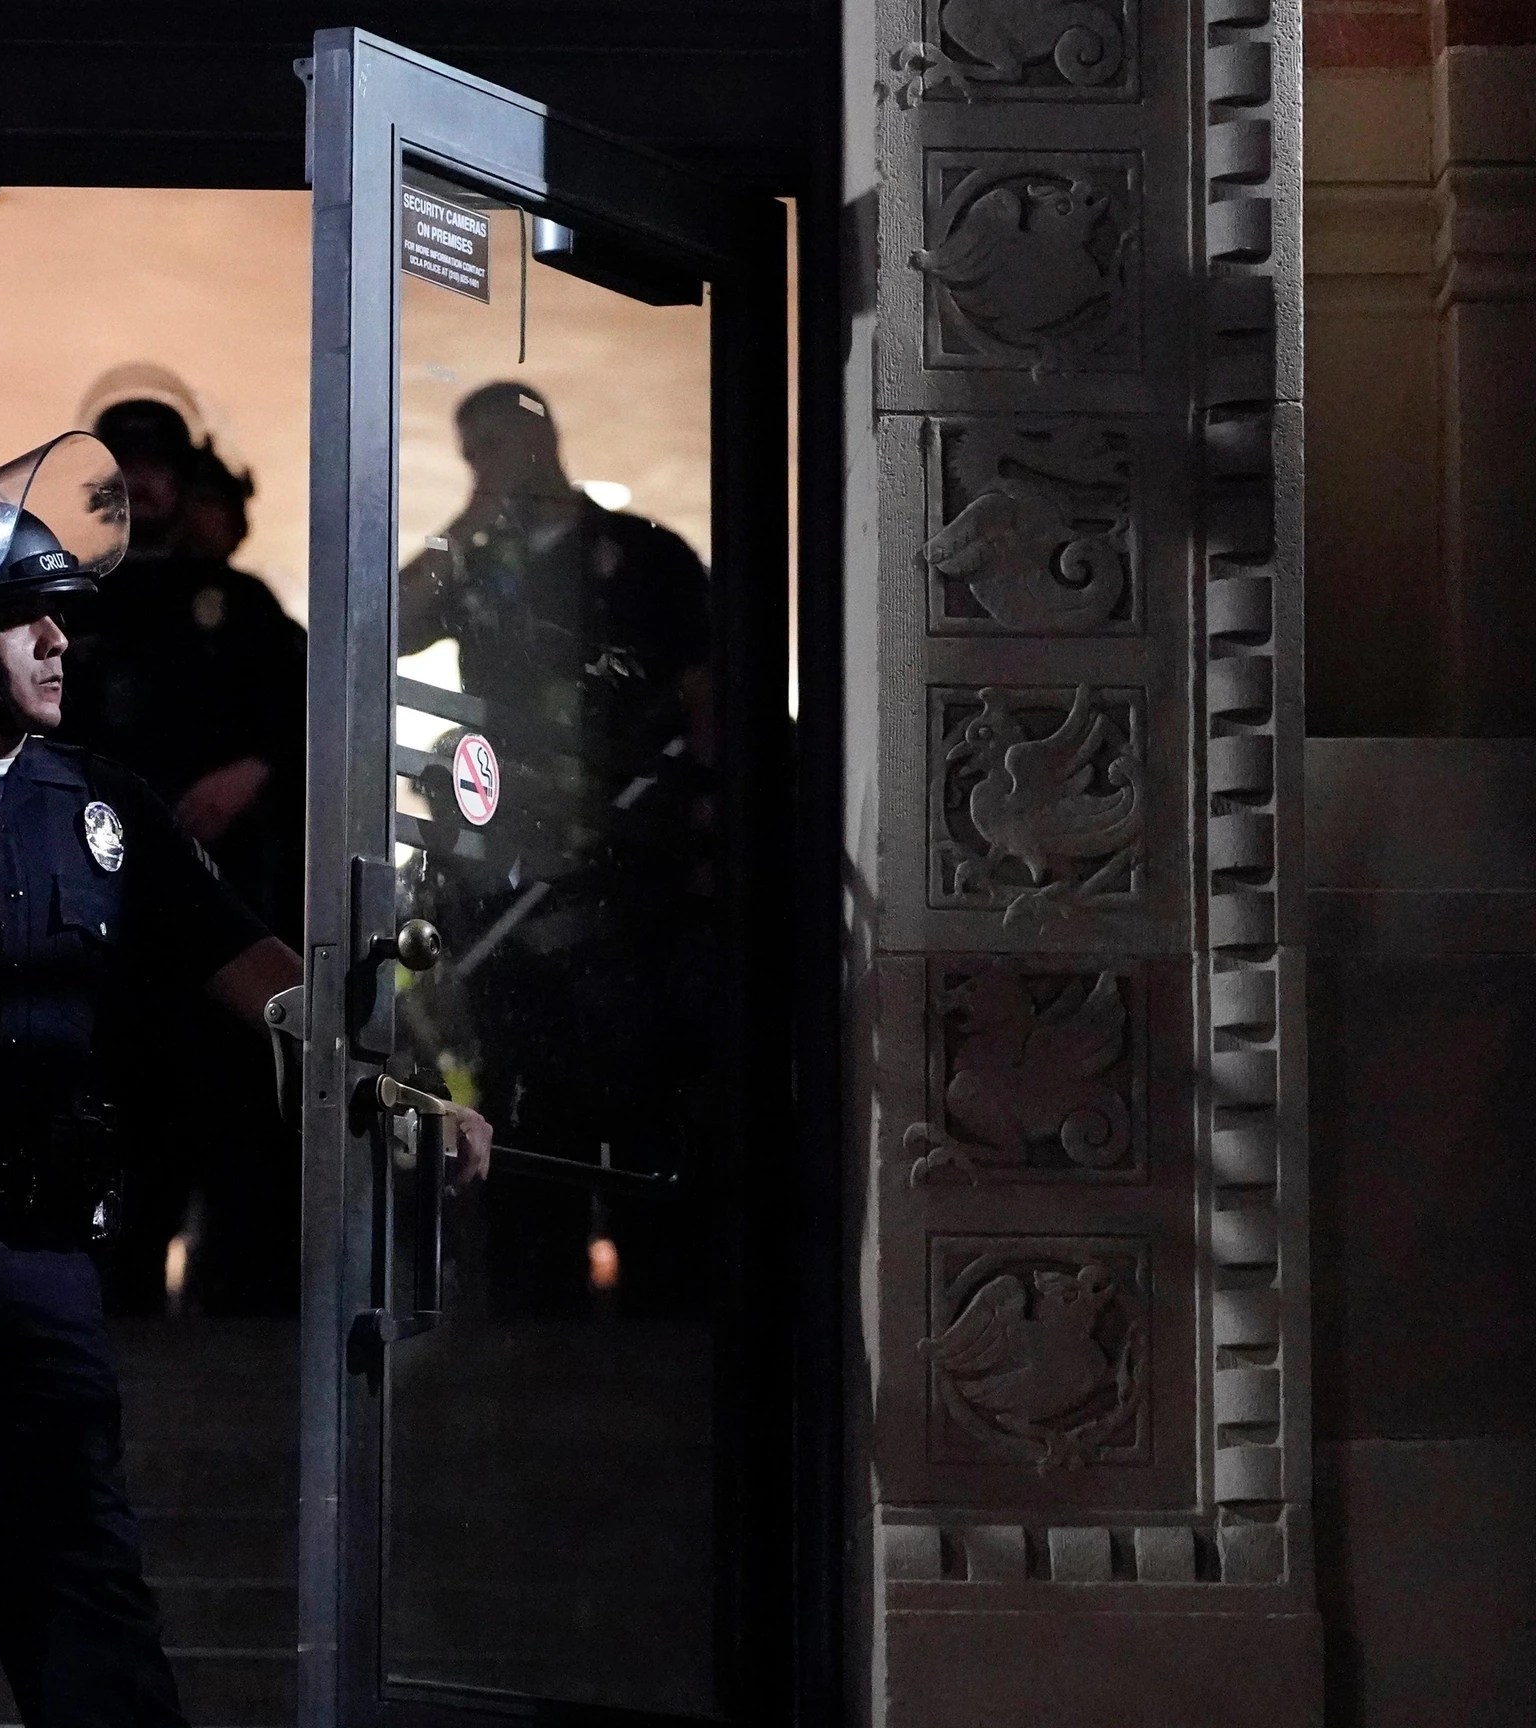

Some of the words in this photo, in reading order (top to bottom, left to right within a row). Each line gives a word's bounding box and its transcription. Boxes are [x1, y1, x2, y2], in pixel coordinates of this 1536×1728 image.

[403, 193, 444, 221] SECURITY
[446, 210, 487, 237] CAMERAS
[417, 221, 430, 238] ON
[431, 226, 473, 255] PREMISES
[404, 239, 415, 251] FOR
[415, 243, 430, 256] MORE
[430, 249, 463, 269] INFORMATION
[462, 262, 485, 277] CONTACT
[409, 255, 423, 267] UCLA
[423, 259, 441, 274] POLICE
[441, 267, 448, 276] AT
[39, 553, 69, 571] CRUZ
